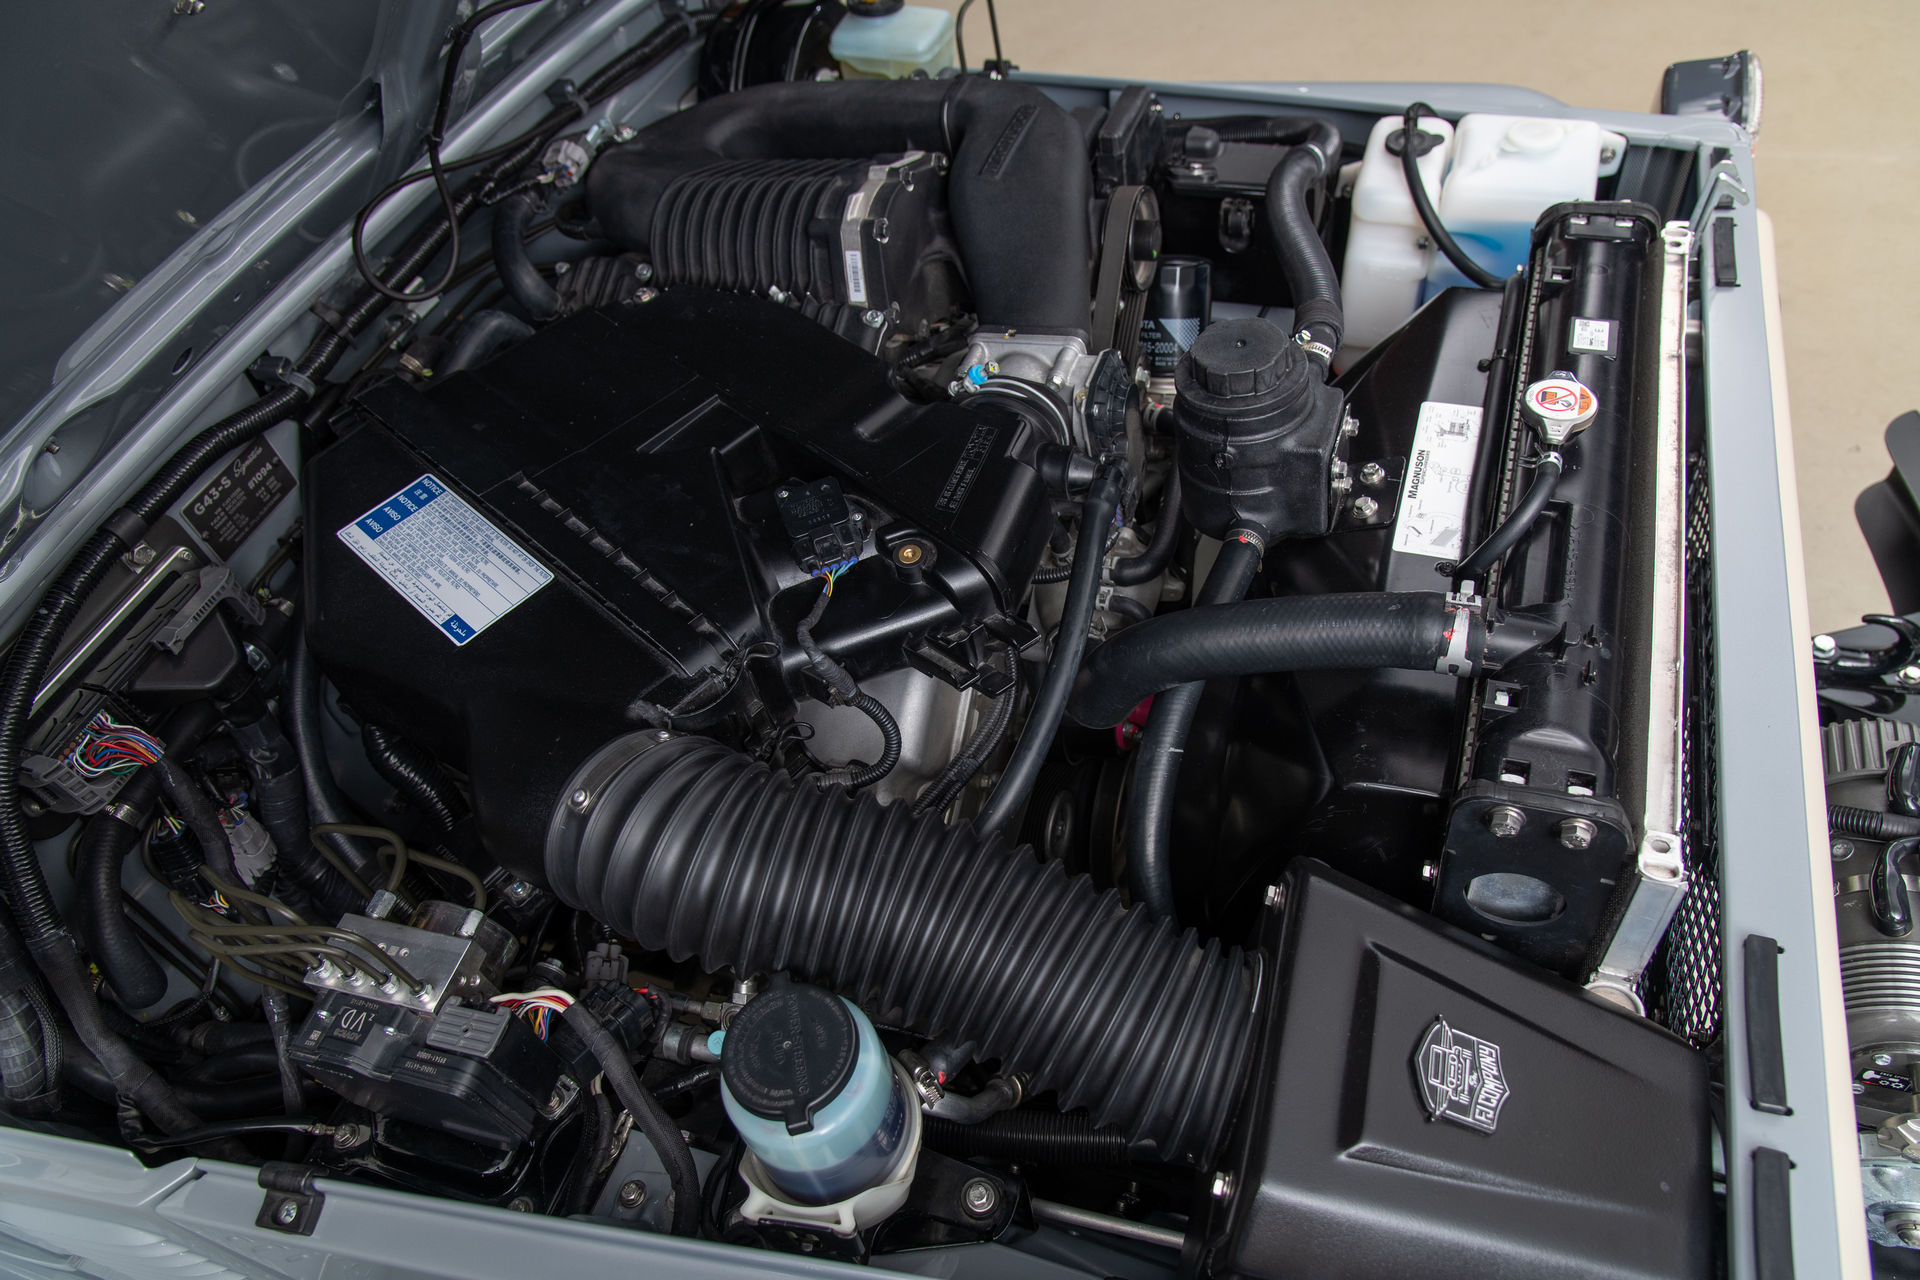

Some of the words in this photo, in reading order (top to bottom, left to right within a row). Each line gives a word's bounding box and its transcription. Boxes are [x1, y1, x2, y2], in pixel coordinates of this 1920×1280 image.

[248, 462, 274, 490] #1094
[1407, 449, 1426, 499] MAGNUSON
[194, 476, 232, 515] G43-S
[421, 478, 442, 495] NOTICE
[383, 506, 401, 521] AVISO
[398, 494, 418, 513] NOTICE
[364, 518, 384, 533] AVISO
[341, 1009, 367, 1032] VD
[1478, 1044, 1504, 1107] COMPANY
[1475, 1104, 1494, 1123] FJ
